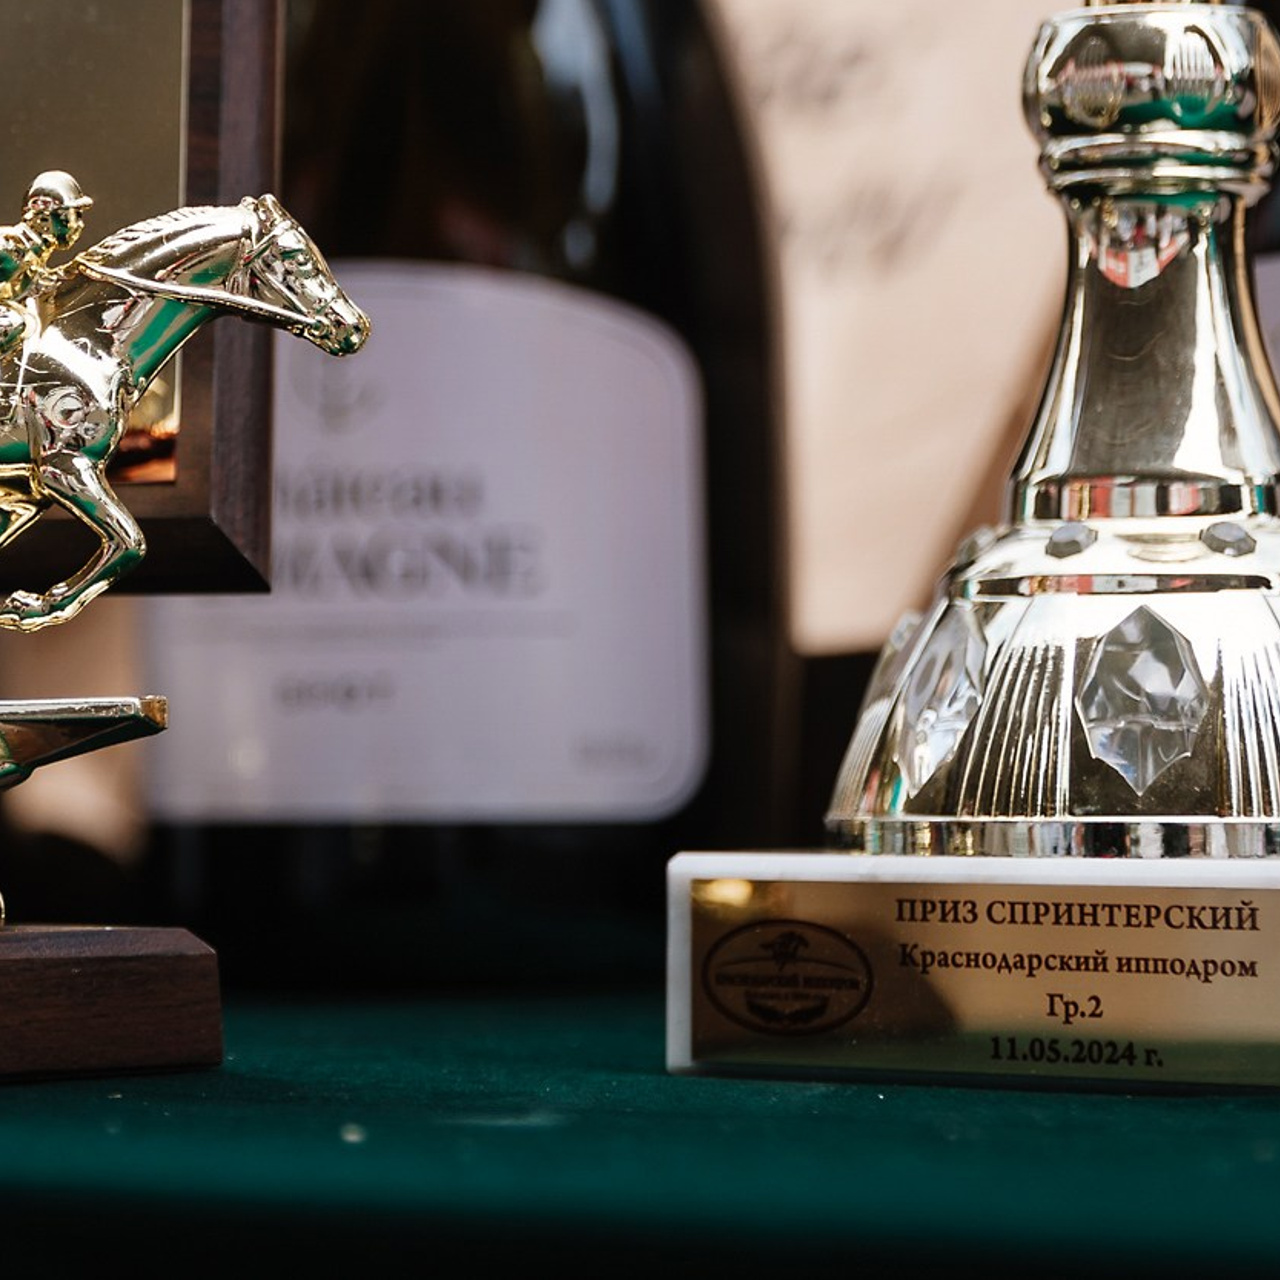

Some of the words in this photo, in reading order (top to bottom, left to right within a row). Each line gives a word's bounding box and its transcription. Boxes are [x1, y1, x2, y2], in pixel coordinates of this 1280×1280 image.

[895, 898, 979, 924] ПРИЗ
[985, 898, 1261, 932] СПРИНТЕРСКИЙ
[899, 943, 1109, 978] Краснодарский
[1115, 955, 1259, 984] ипподром
[1045, 992, 1104, 1026] Гр.2
[989, 1035, 1135, 1068] 11.05.2024
[1139, 1042, 1164, 1068] г.
